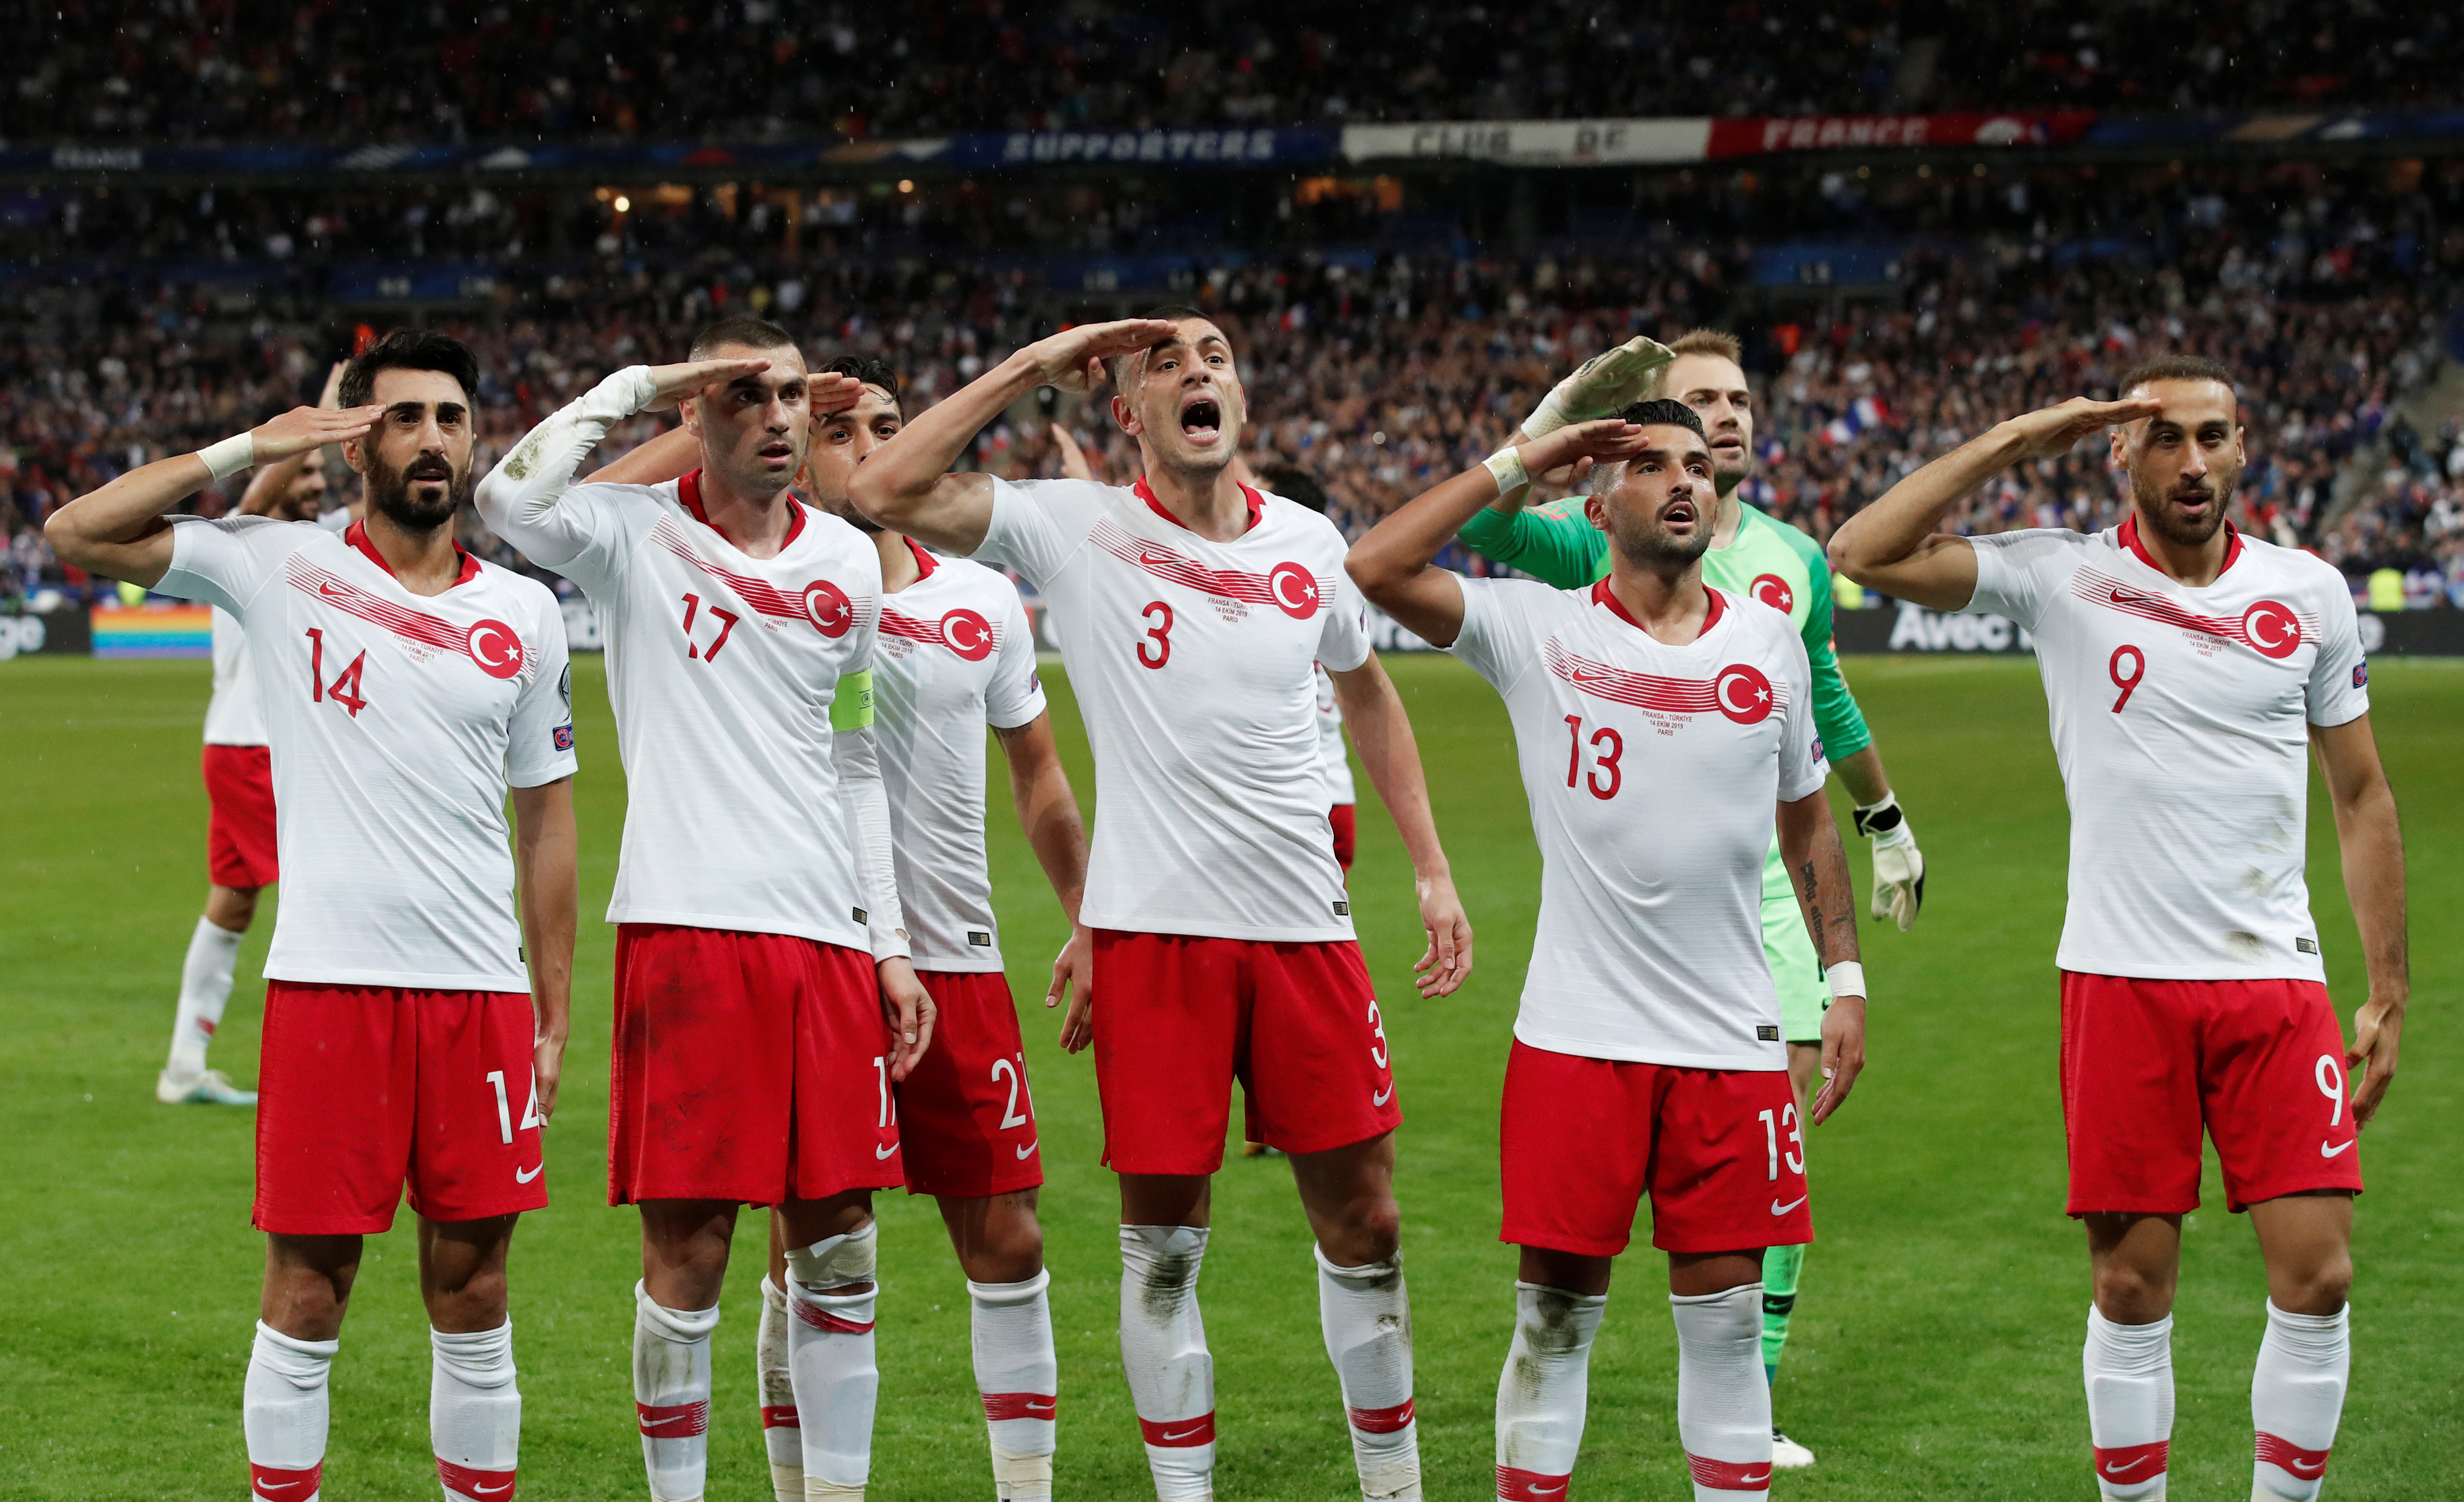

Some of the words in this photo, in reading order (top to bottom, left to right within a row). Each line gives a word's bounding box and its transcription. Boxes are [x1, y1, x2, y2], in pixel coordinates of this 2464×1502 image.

[1003, 130, 1276, 161] SUPPORTERS
[1761, 117, 1930, 152] FRANCE
[682, 593, 739, 663] 17
[1137, 601, 1173, 669] 3
[1208, 597, 1229, 607] FRANSA
[306, 628, 367, 718] 14
[394, 634, 416, 646] FRANSA
[421, 643, 444, 655] TÜRKİYE
[409, 646, 421, 655] EKİM
[423, 651, 435, 659] 2019
[409, 654, 425, 663] PARİS
[899, 639, 921, 649] TÜRKİYE
[2182, 632, 2203, 641] FRANSA
[2208, 636, 2231, 646] TÜRKİYE
[2110, 644, 2145, 714] 9
[1642, 711, 1664, 720] FRANSA
[1565, 714, 1623, 800] 13
[1368, 1000, 1387, 1069] 3
[486, 1061, 540, 1144] 14
[2315, 1054, 2343, 1126] 9
[1758, 1103, 1805, 1181] 13
